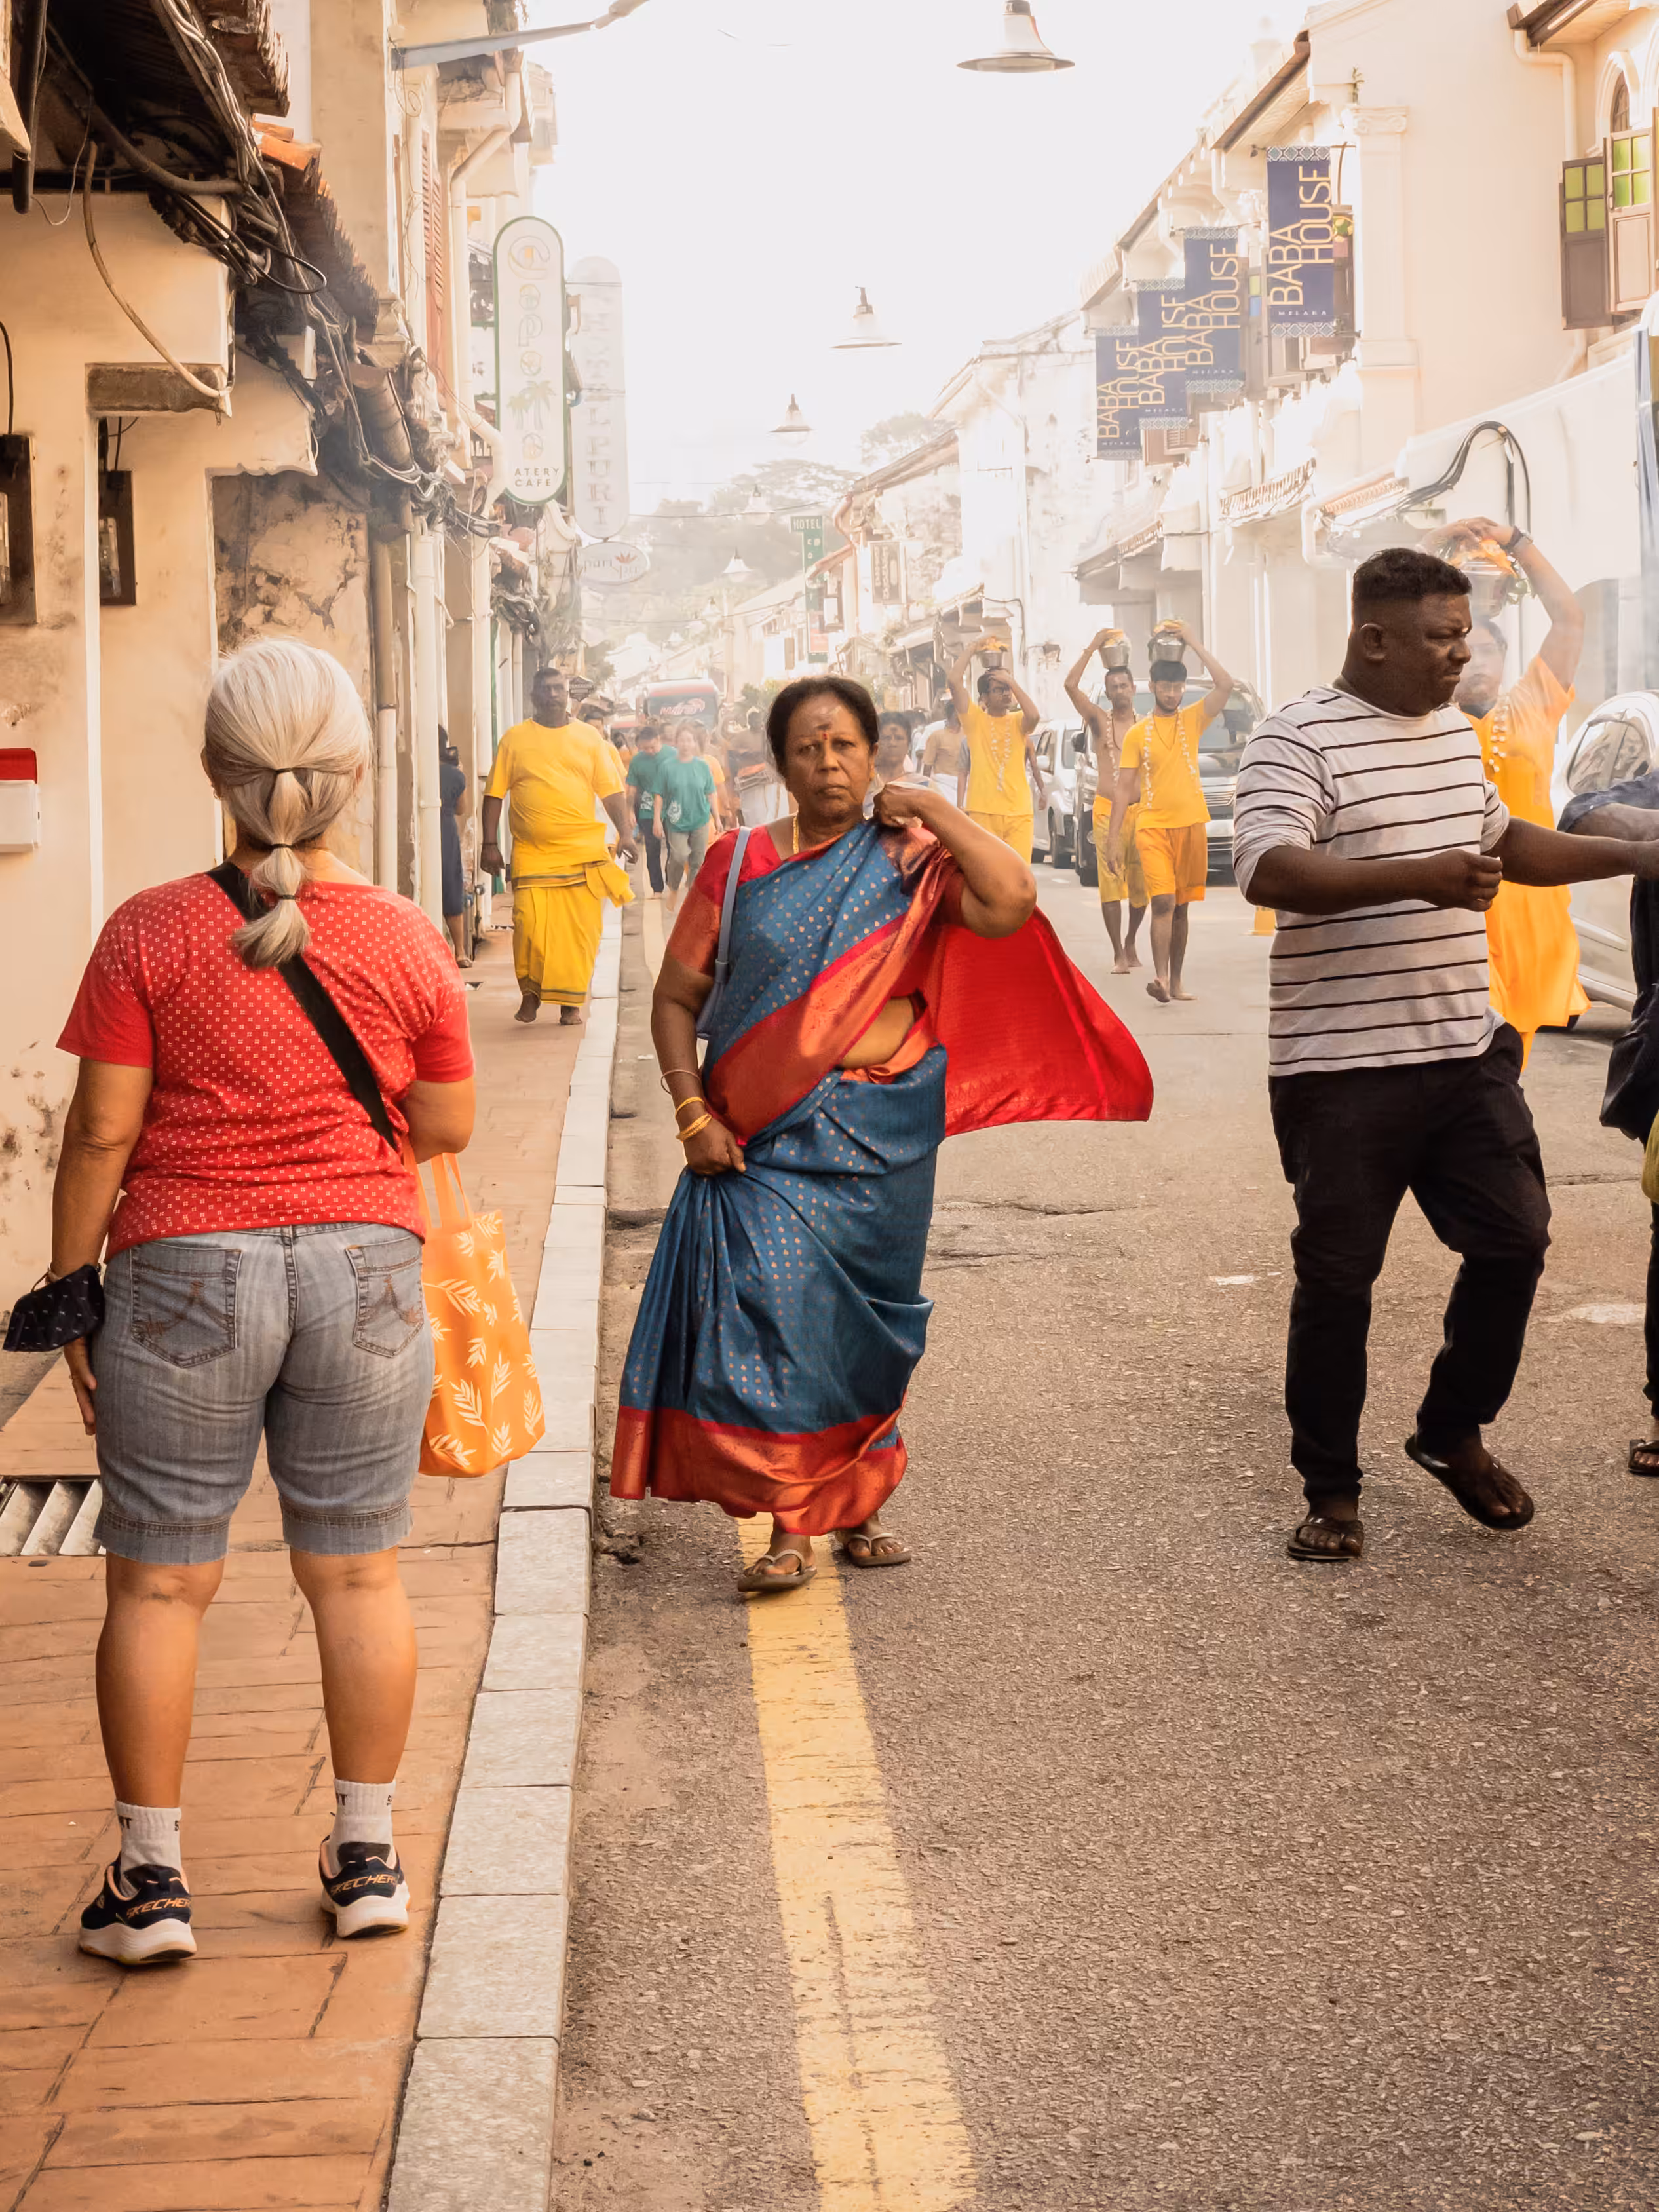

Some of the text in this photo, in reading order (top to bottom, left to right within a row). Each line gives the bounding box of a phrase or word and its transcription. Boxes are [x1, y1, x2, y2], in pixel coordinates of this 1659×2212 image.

[1299, 166, 1335, 263] HOUSE
[1210, 243, 1240, 328] HOUSE
[1268, 221, 1303, 306] BABA
[1183, 291, 1213, 365] BABA
[1116, 340, 1139, 408] HOUSE
[1138, 338, 1165, 404] BABA
[1097, 381, 1120, 438] BABA
[514, 467, 559, 476] ATERY
[793, 518, 822, 531] HOTEL
